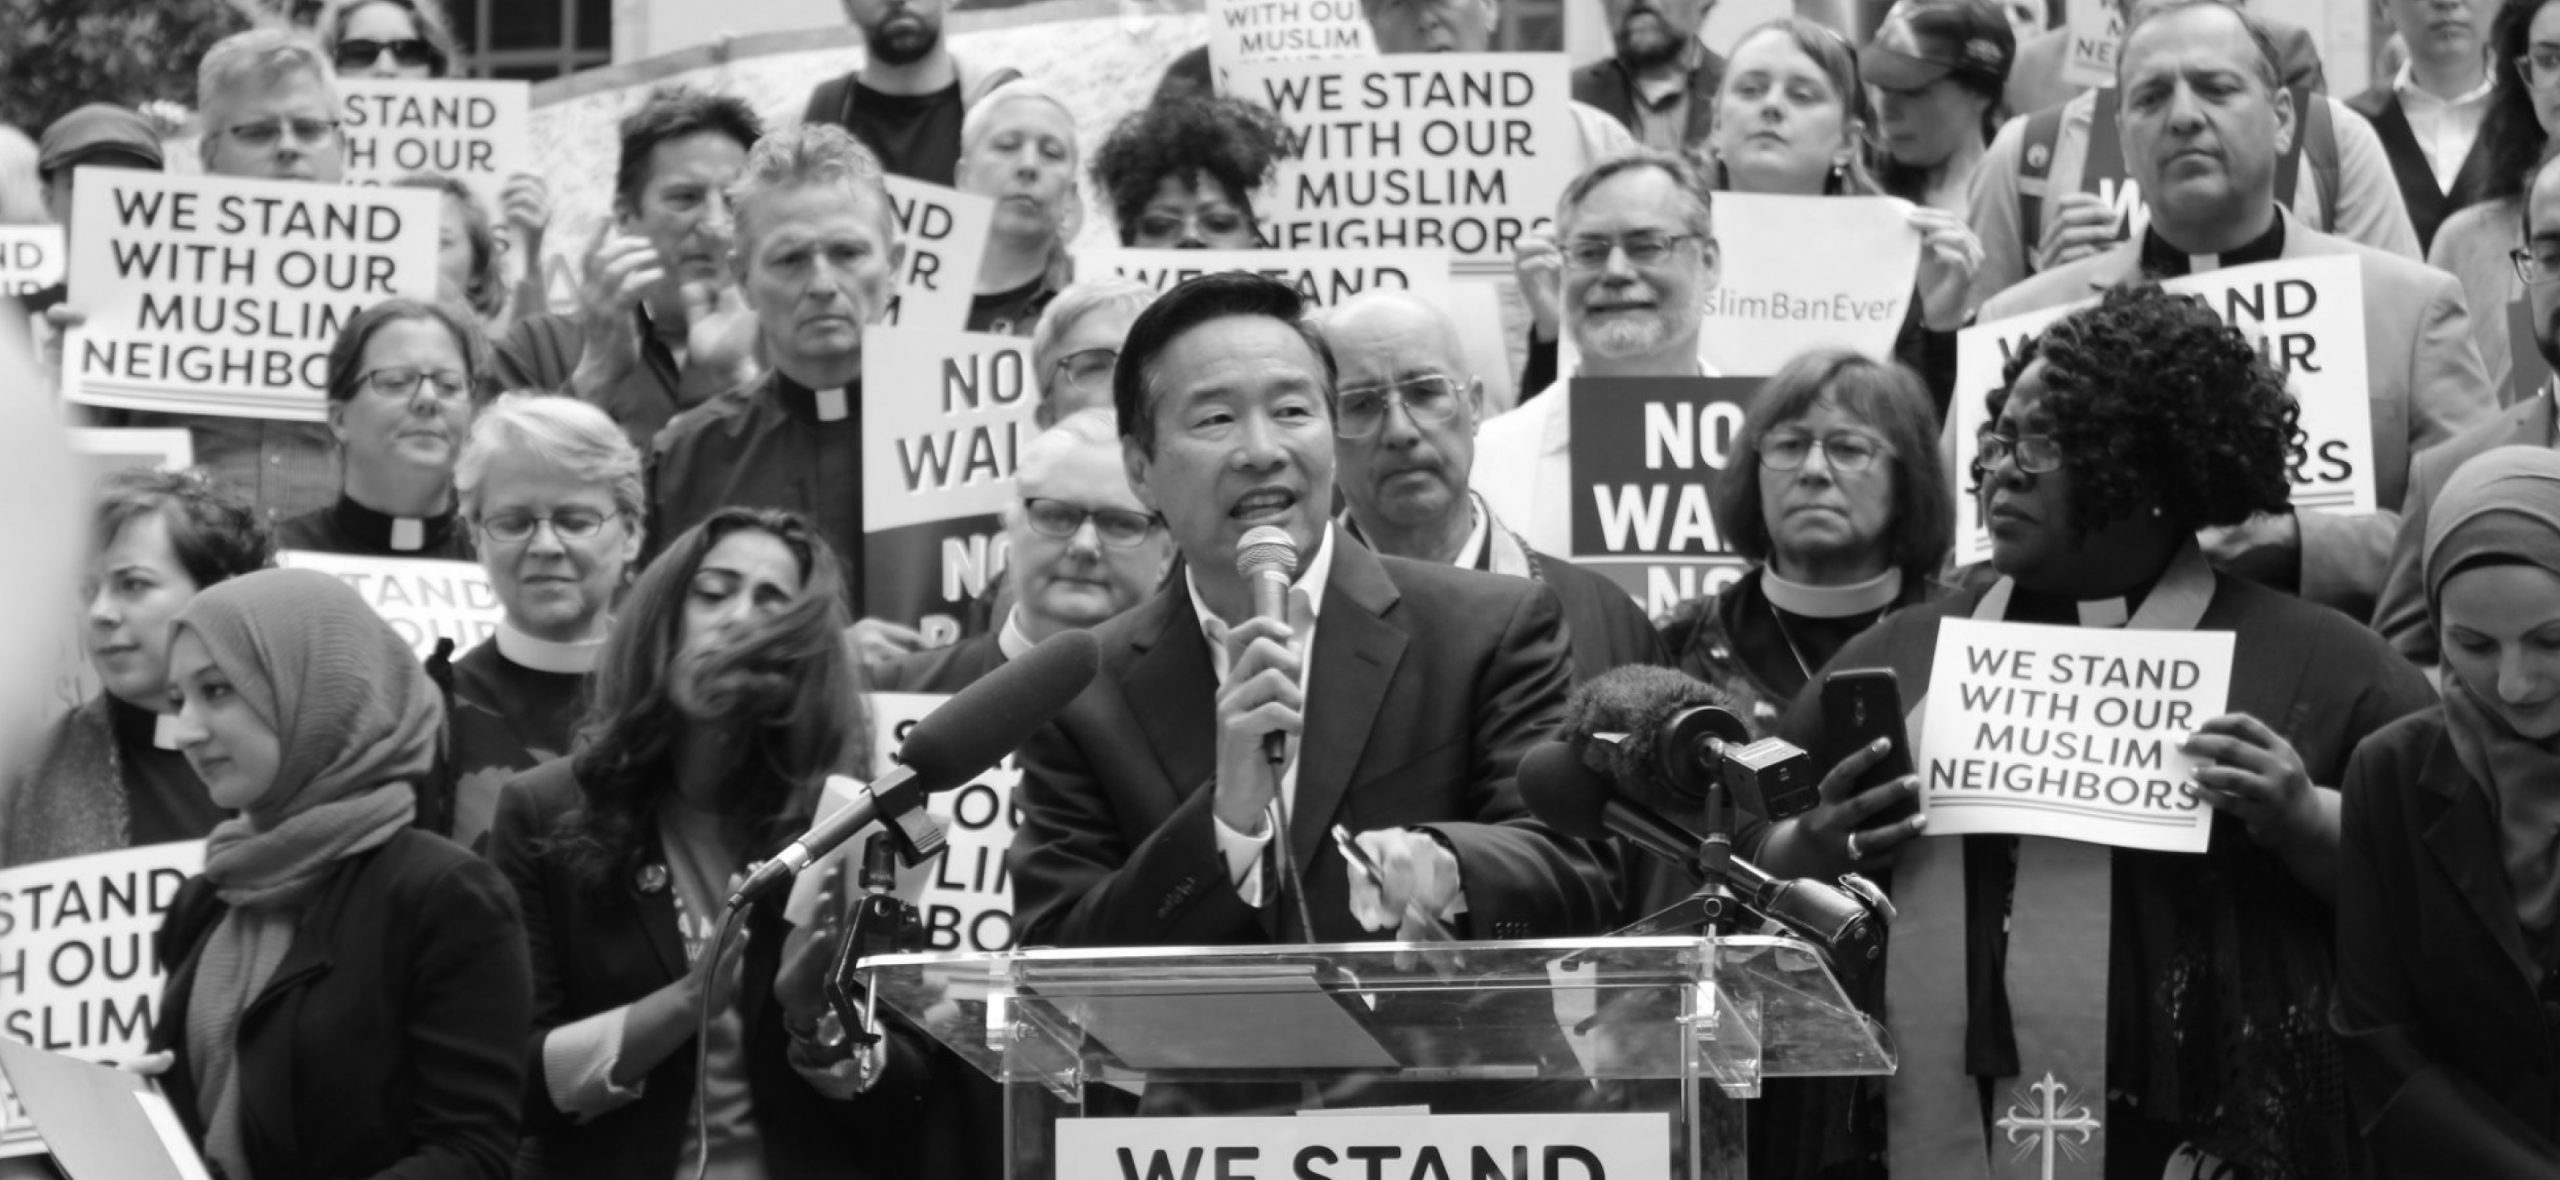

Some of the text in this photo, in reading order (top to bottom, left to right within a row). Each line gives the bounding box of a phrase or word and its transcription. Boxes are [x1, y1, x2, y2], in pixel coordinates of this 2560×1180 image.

[1224, 2, 1299, 28] WITH
[1239, 28, 1360, 54] MUSLIM
[343, 94, 496, 129] STAND
[1263, 74, 1343, 112] WE
[1361, 71, 1534, 109] STAND
[394, 138, 495, 172] OUR
[1421, 120, 1535, 157] OUR
[1297, 169, 1506, 210] MUSLIM
[113, 188, 402, 243] WE STAND
[111, 239, 398, 294] WITH OUR
[941, 348, 1024, 415] NO
[1644, 401, 1746, 471] NO
[1592, 483, 1734, 552] WA
[1966, 645, 2201, 691] WE STAND
[1960, 682, 2193, 731] WITH OUR
[1974, 722, 2163, 770] MUSLIM
[1929, 758, 2201, 812] NEIGHBORS
